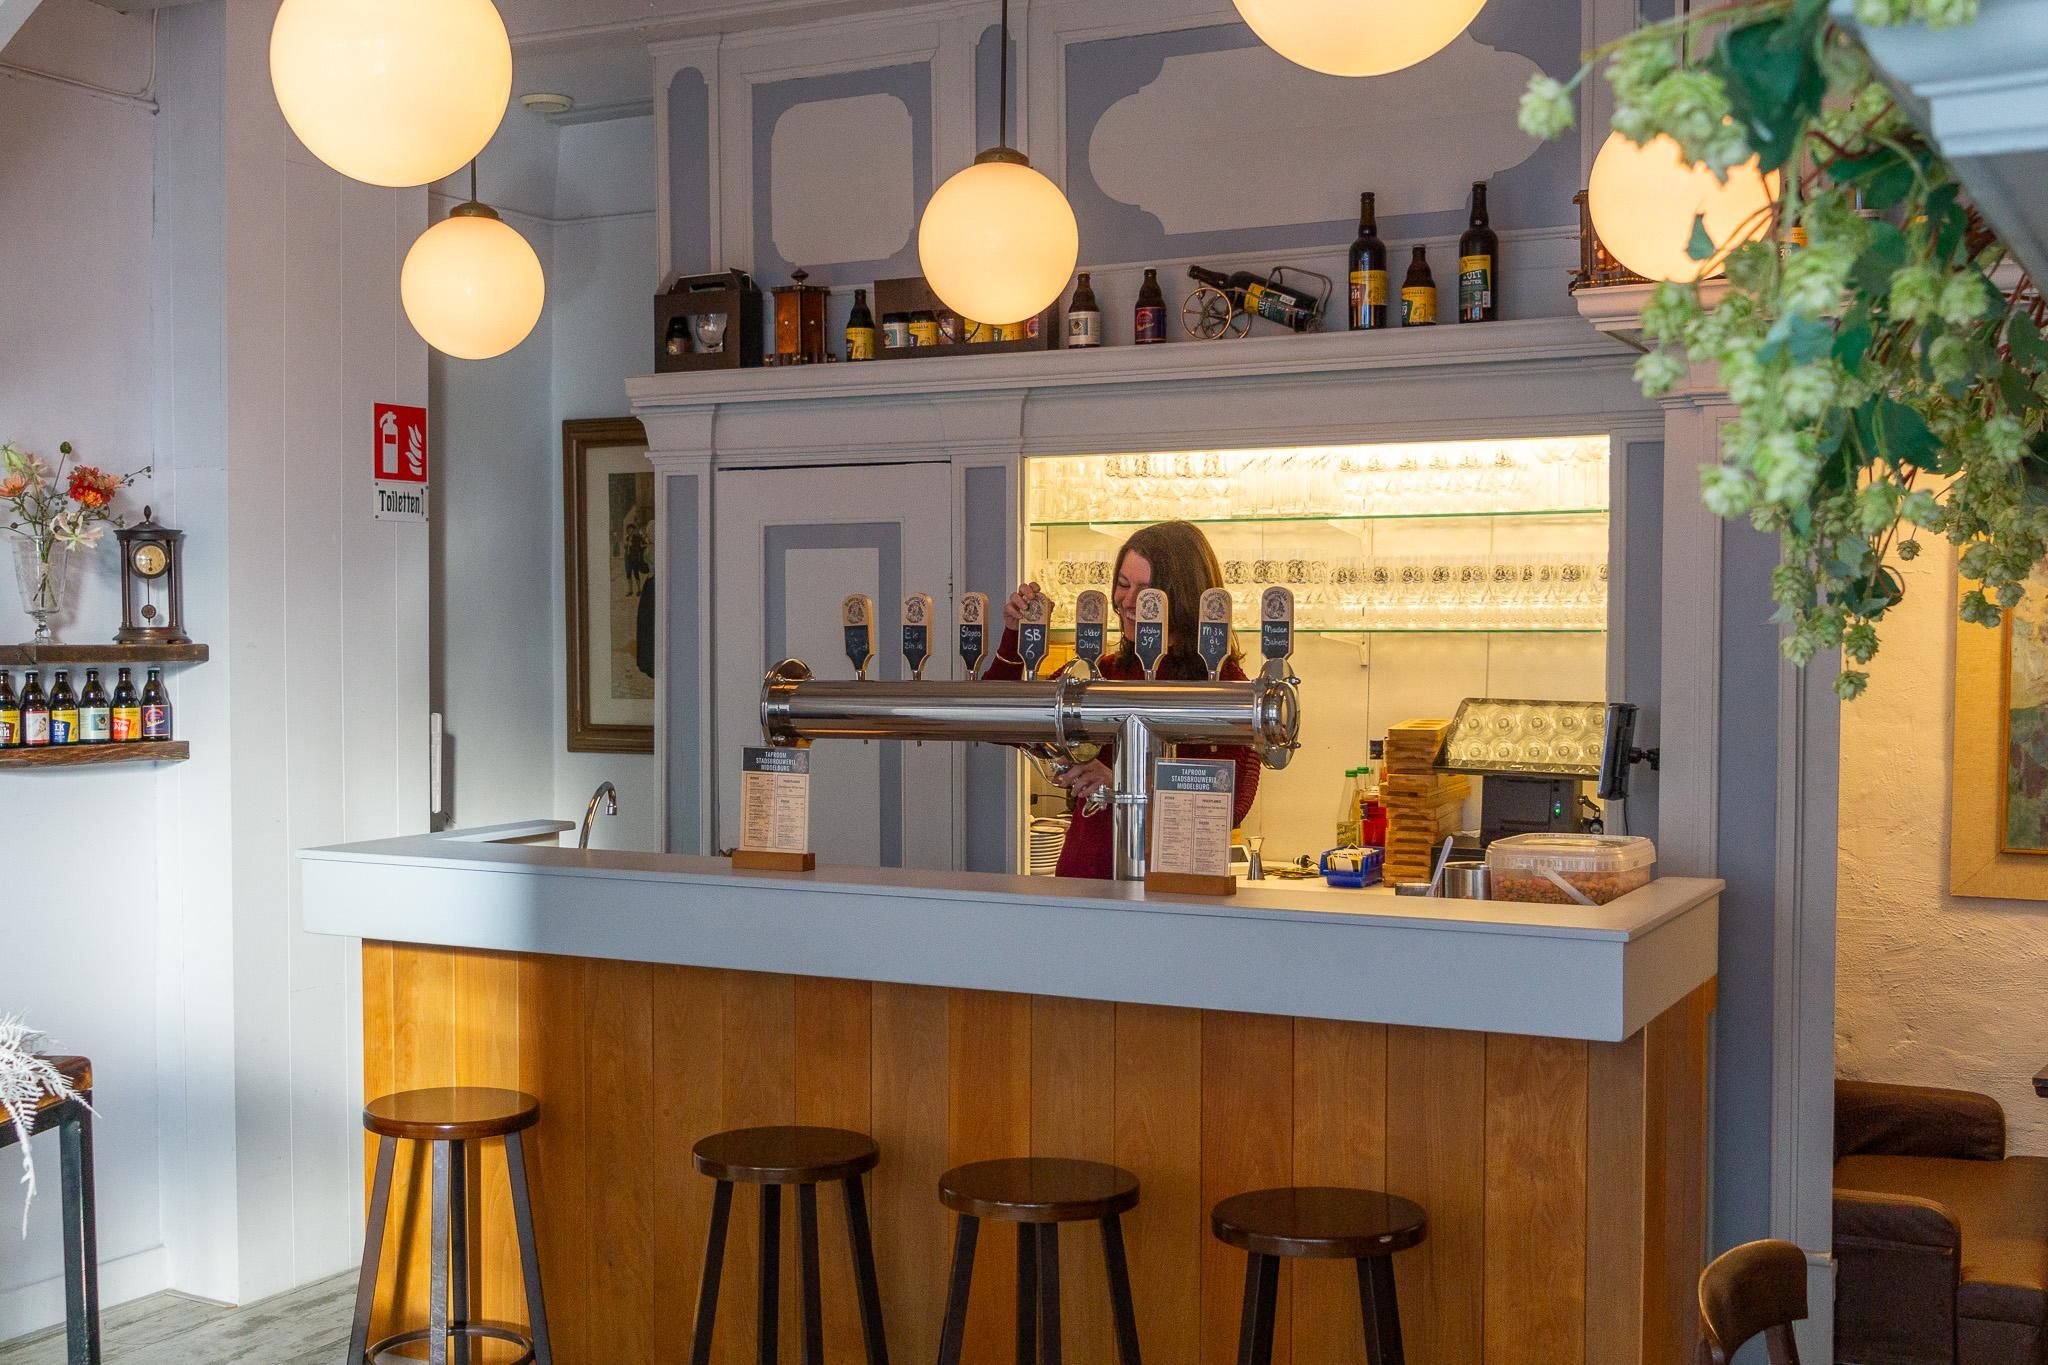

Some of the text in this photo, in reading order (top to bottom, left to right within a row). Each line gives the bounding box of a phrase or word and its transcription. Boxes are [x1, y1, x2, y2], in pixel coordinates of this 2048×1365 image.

[379, 490, 420, 514] Toiletten
[1024, 628, 1042, 641] SB
[1141, 636, 1154, 649] 39
[1025, 643, 1035, 660] 6
[1171, 776, 1217, 784] STADSBROUWERIJ
